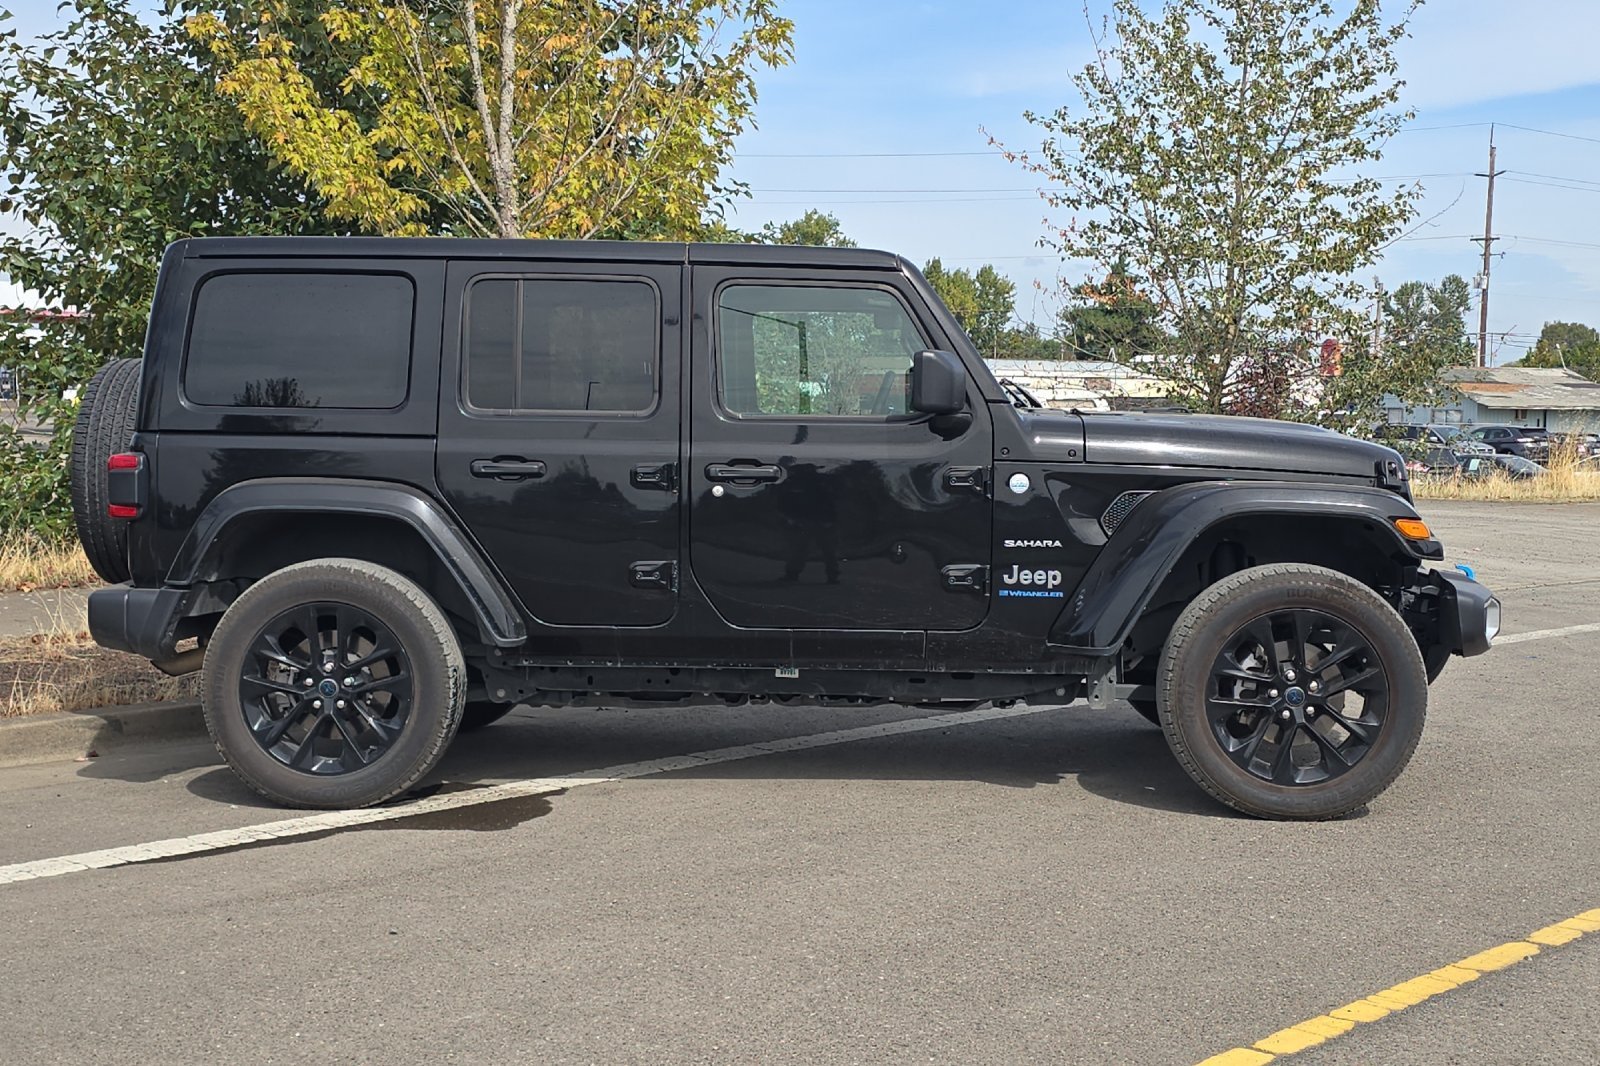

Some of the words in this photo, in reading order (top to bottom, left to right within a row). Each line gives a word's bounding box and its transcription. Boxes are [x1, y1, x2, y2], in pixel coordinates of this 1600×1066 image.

[1004, 539, 1063, 548] SAHARA
[1003, 564, 1062, 589] Jeep
[1008, 590, 1064, 598] WRANGLER
